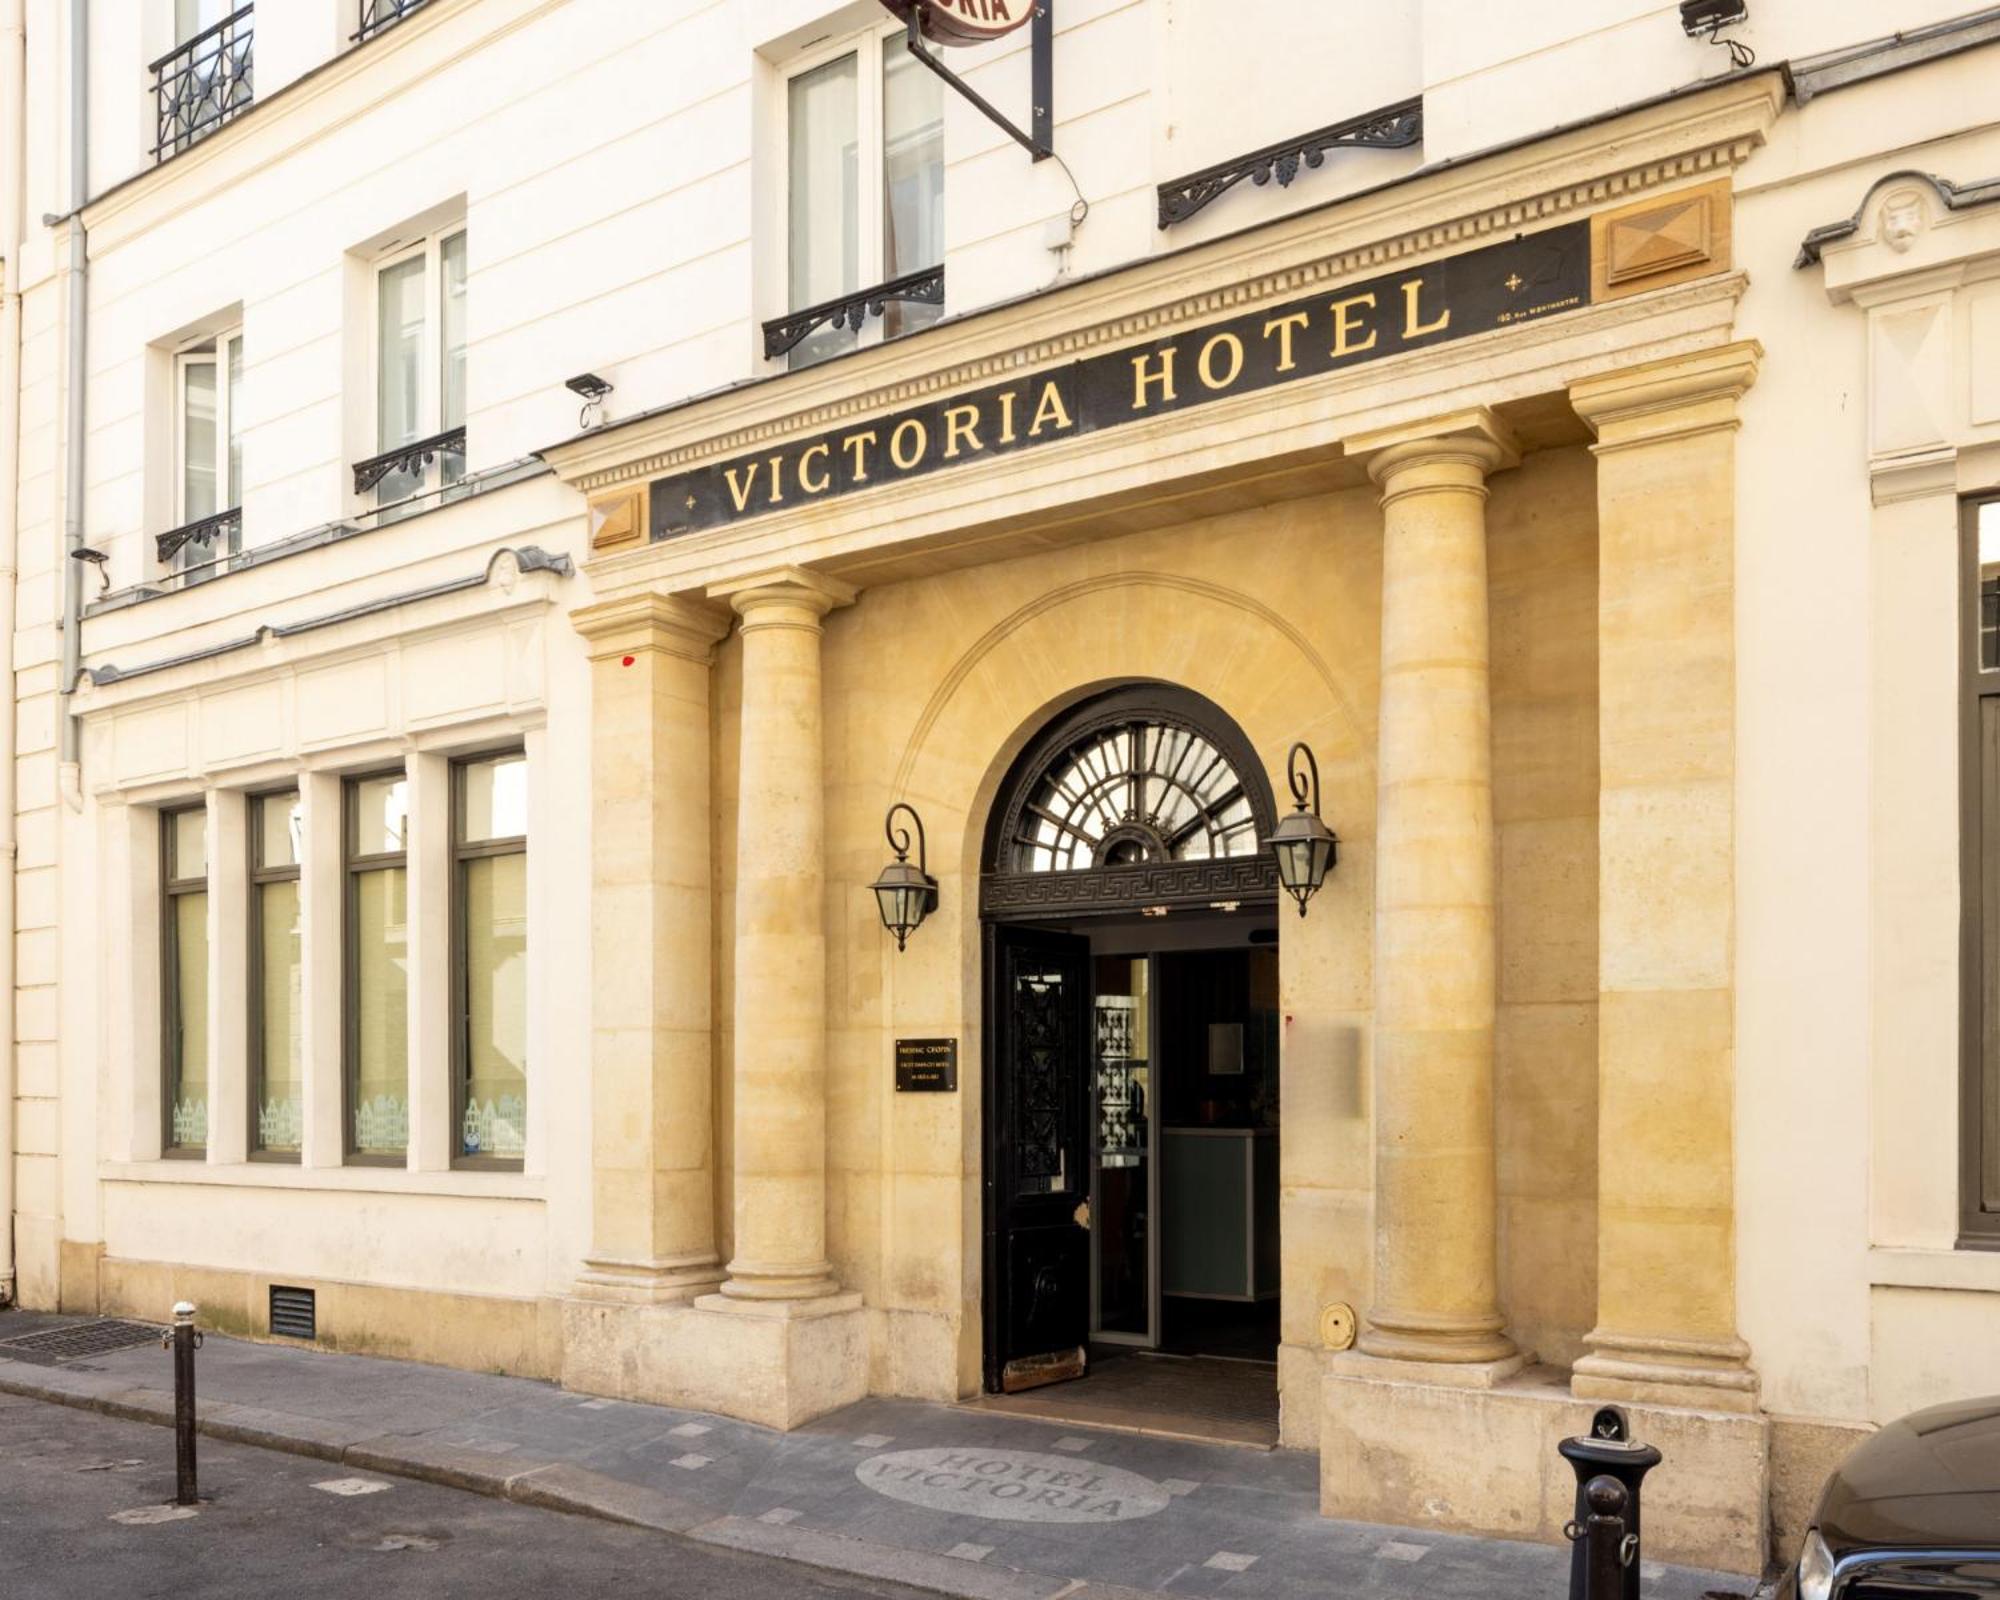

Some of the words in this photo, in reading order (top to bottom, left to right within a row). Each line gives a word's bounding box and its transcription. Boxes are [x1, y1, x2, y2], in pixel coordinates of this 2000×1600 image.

[724, 380, 1073, 512] VICTORIA
[1131, 277, 1450, 410] HOTEL
[874, 1463, 1123, 1516] VICTORIA
[935, 1454, 1106, 1492] HOTEL
